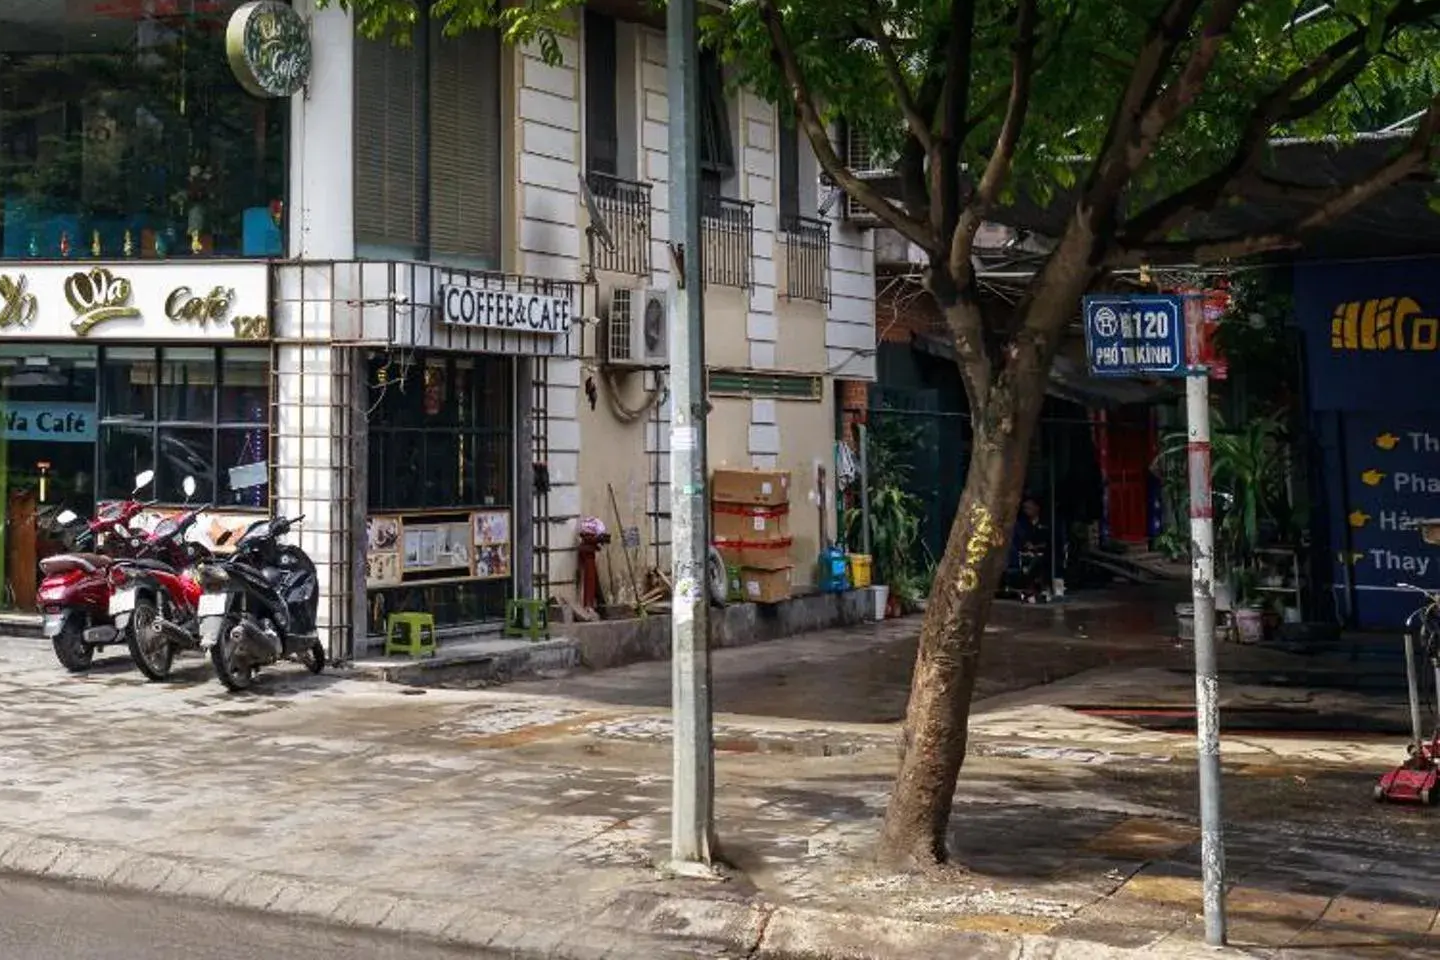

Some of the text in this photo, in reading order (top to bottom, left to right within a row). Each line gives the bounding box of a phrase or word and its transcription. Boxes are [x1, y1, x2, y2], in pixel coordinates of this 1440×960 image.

[164, 285, 236, 329] Café
[446, 288, 570, 331] COFFEE&CAFE
[1133, 310, 1169, 339] 120
[35, 410, 86, 433] Café
[1369, 548, 1430, 575] Thay
